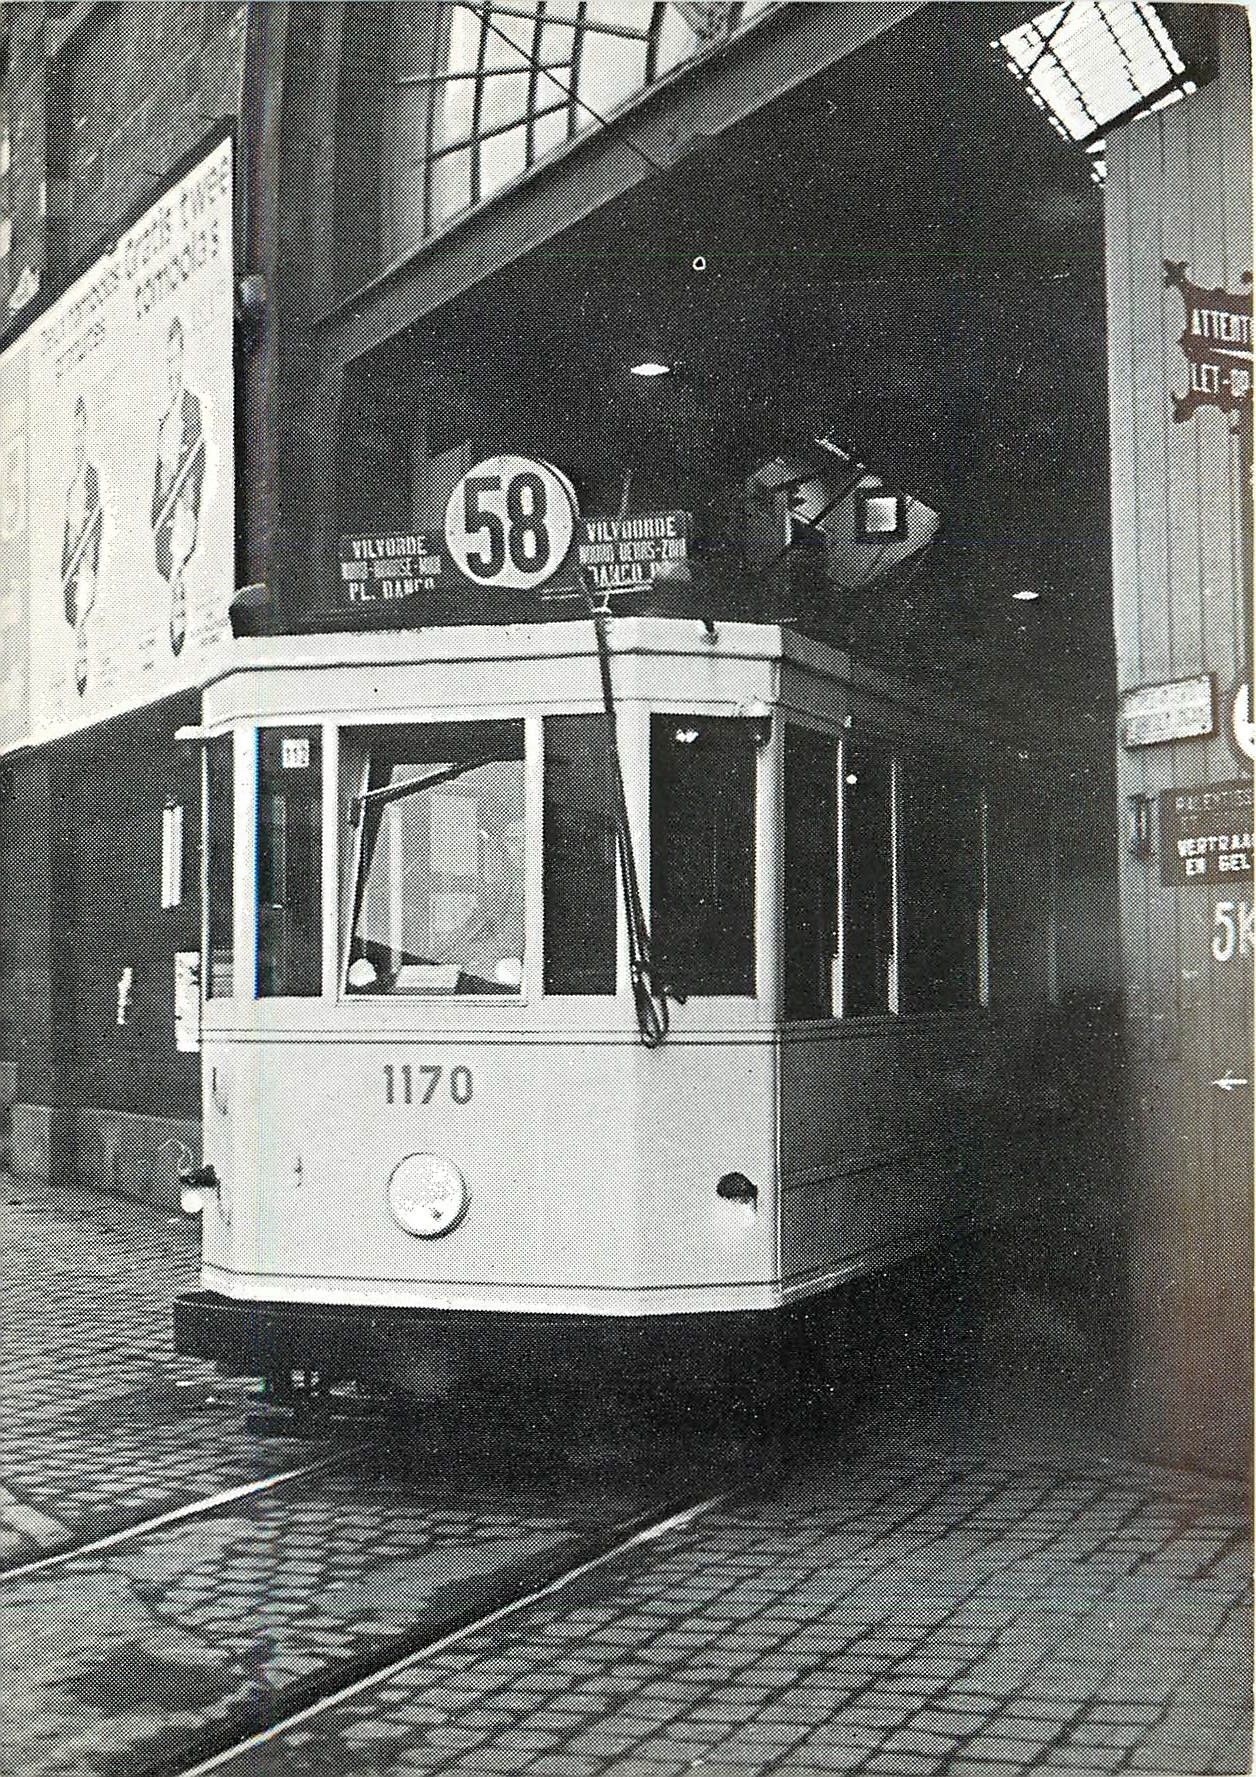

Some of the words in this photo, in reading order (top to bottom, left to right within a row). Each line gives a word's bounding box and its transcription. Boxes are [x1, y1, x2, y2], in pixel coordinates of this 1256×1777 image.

[463, 472, 547, 579] 58
[585, 515, 677, 543] VILVOORDE
[351, 534, 428, 559] VILVORDE
[348, 581, 376, 602] PL.
[1176, 832, 1254, 858] VERTRAA
[1185, 857, 1206, 877] EN
[382, 1063, 474, 1105] 1170
